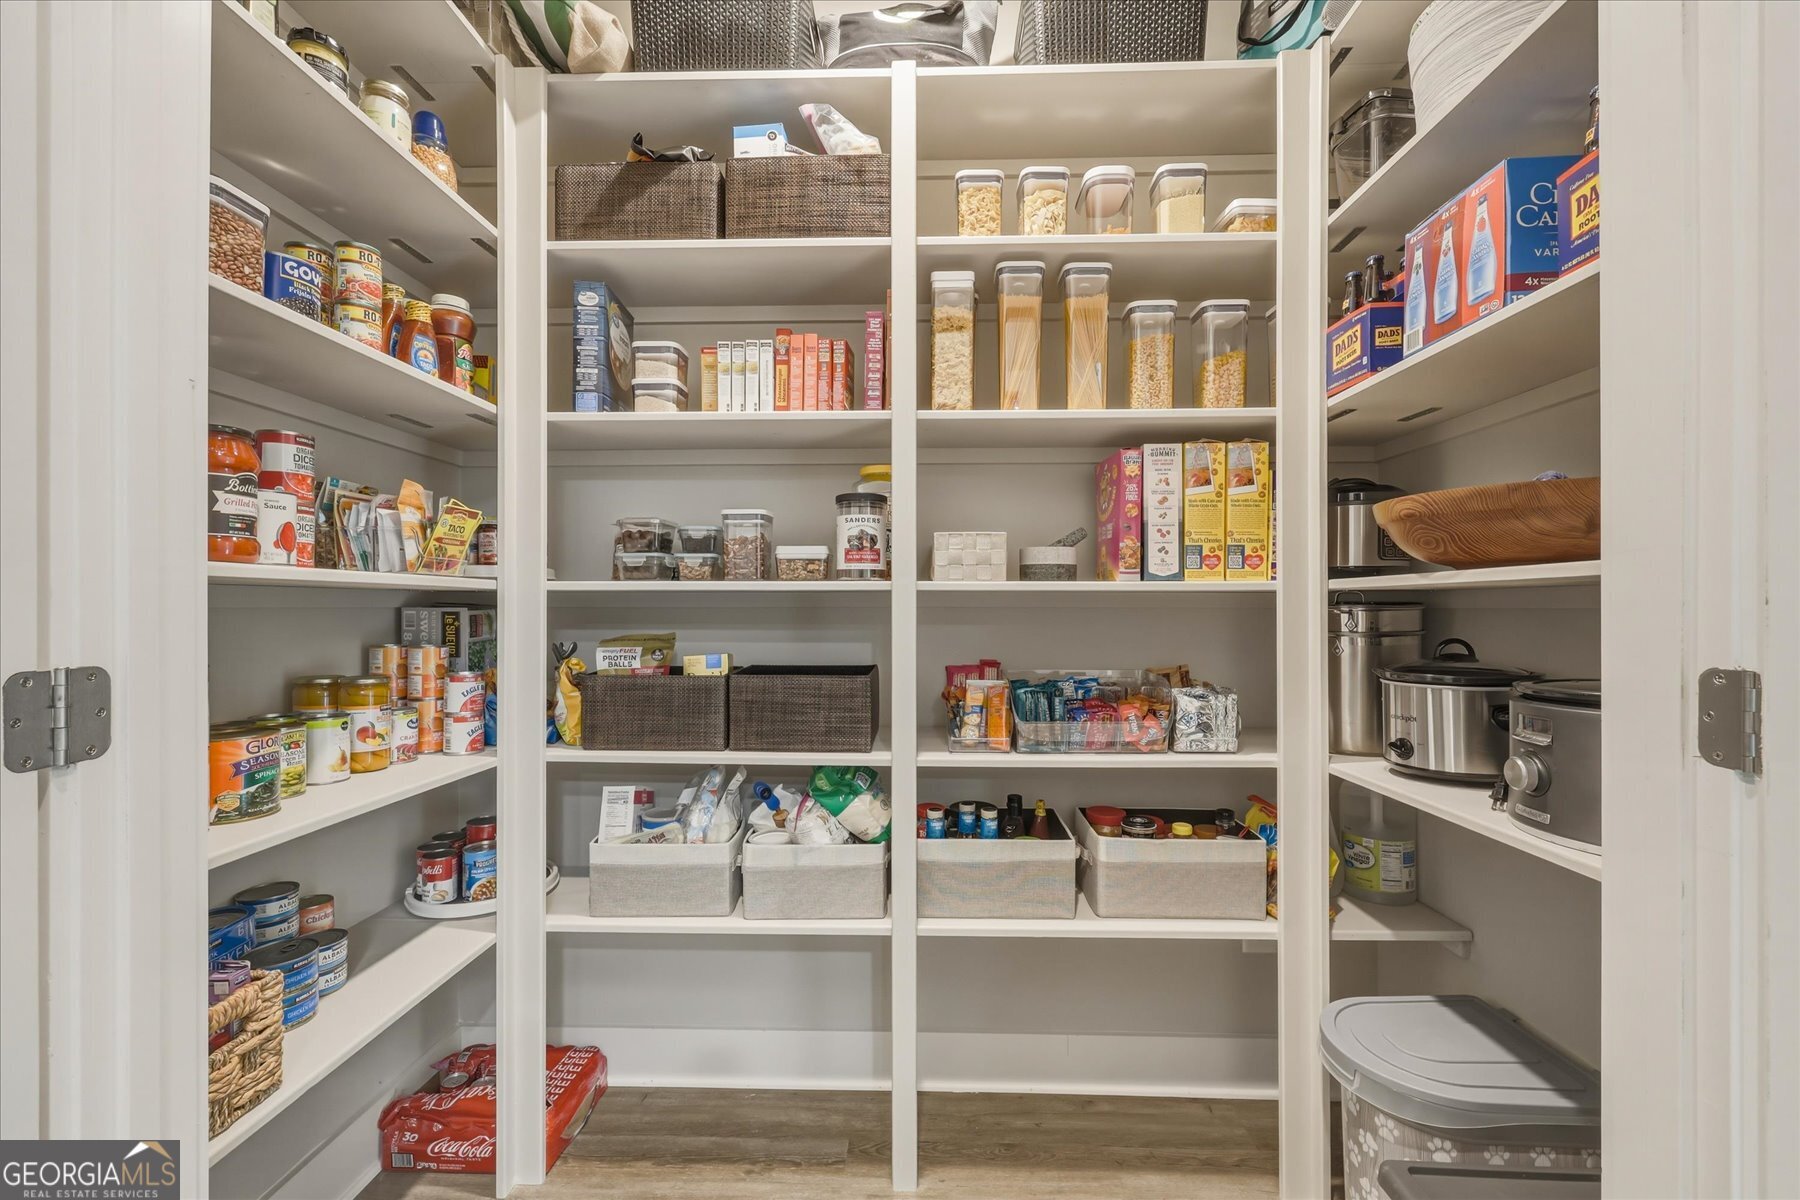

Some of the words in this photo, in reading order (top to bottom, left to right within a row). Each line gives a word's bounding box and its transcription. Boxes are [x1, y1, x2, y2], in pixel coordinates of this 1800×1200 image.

[1525, 276, 1539, 286] 4x
[223, 497, 251, 508] Grilled
[264, 503, 287, 511] Sauce
[448, 524, 465, 534] TACO
[602, 654, 637, 662] PROTEIN
[402, 1131, 419, 1142] 30
